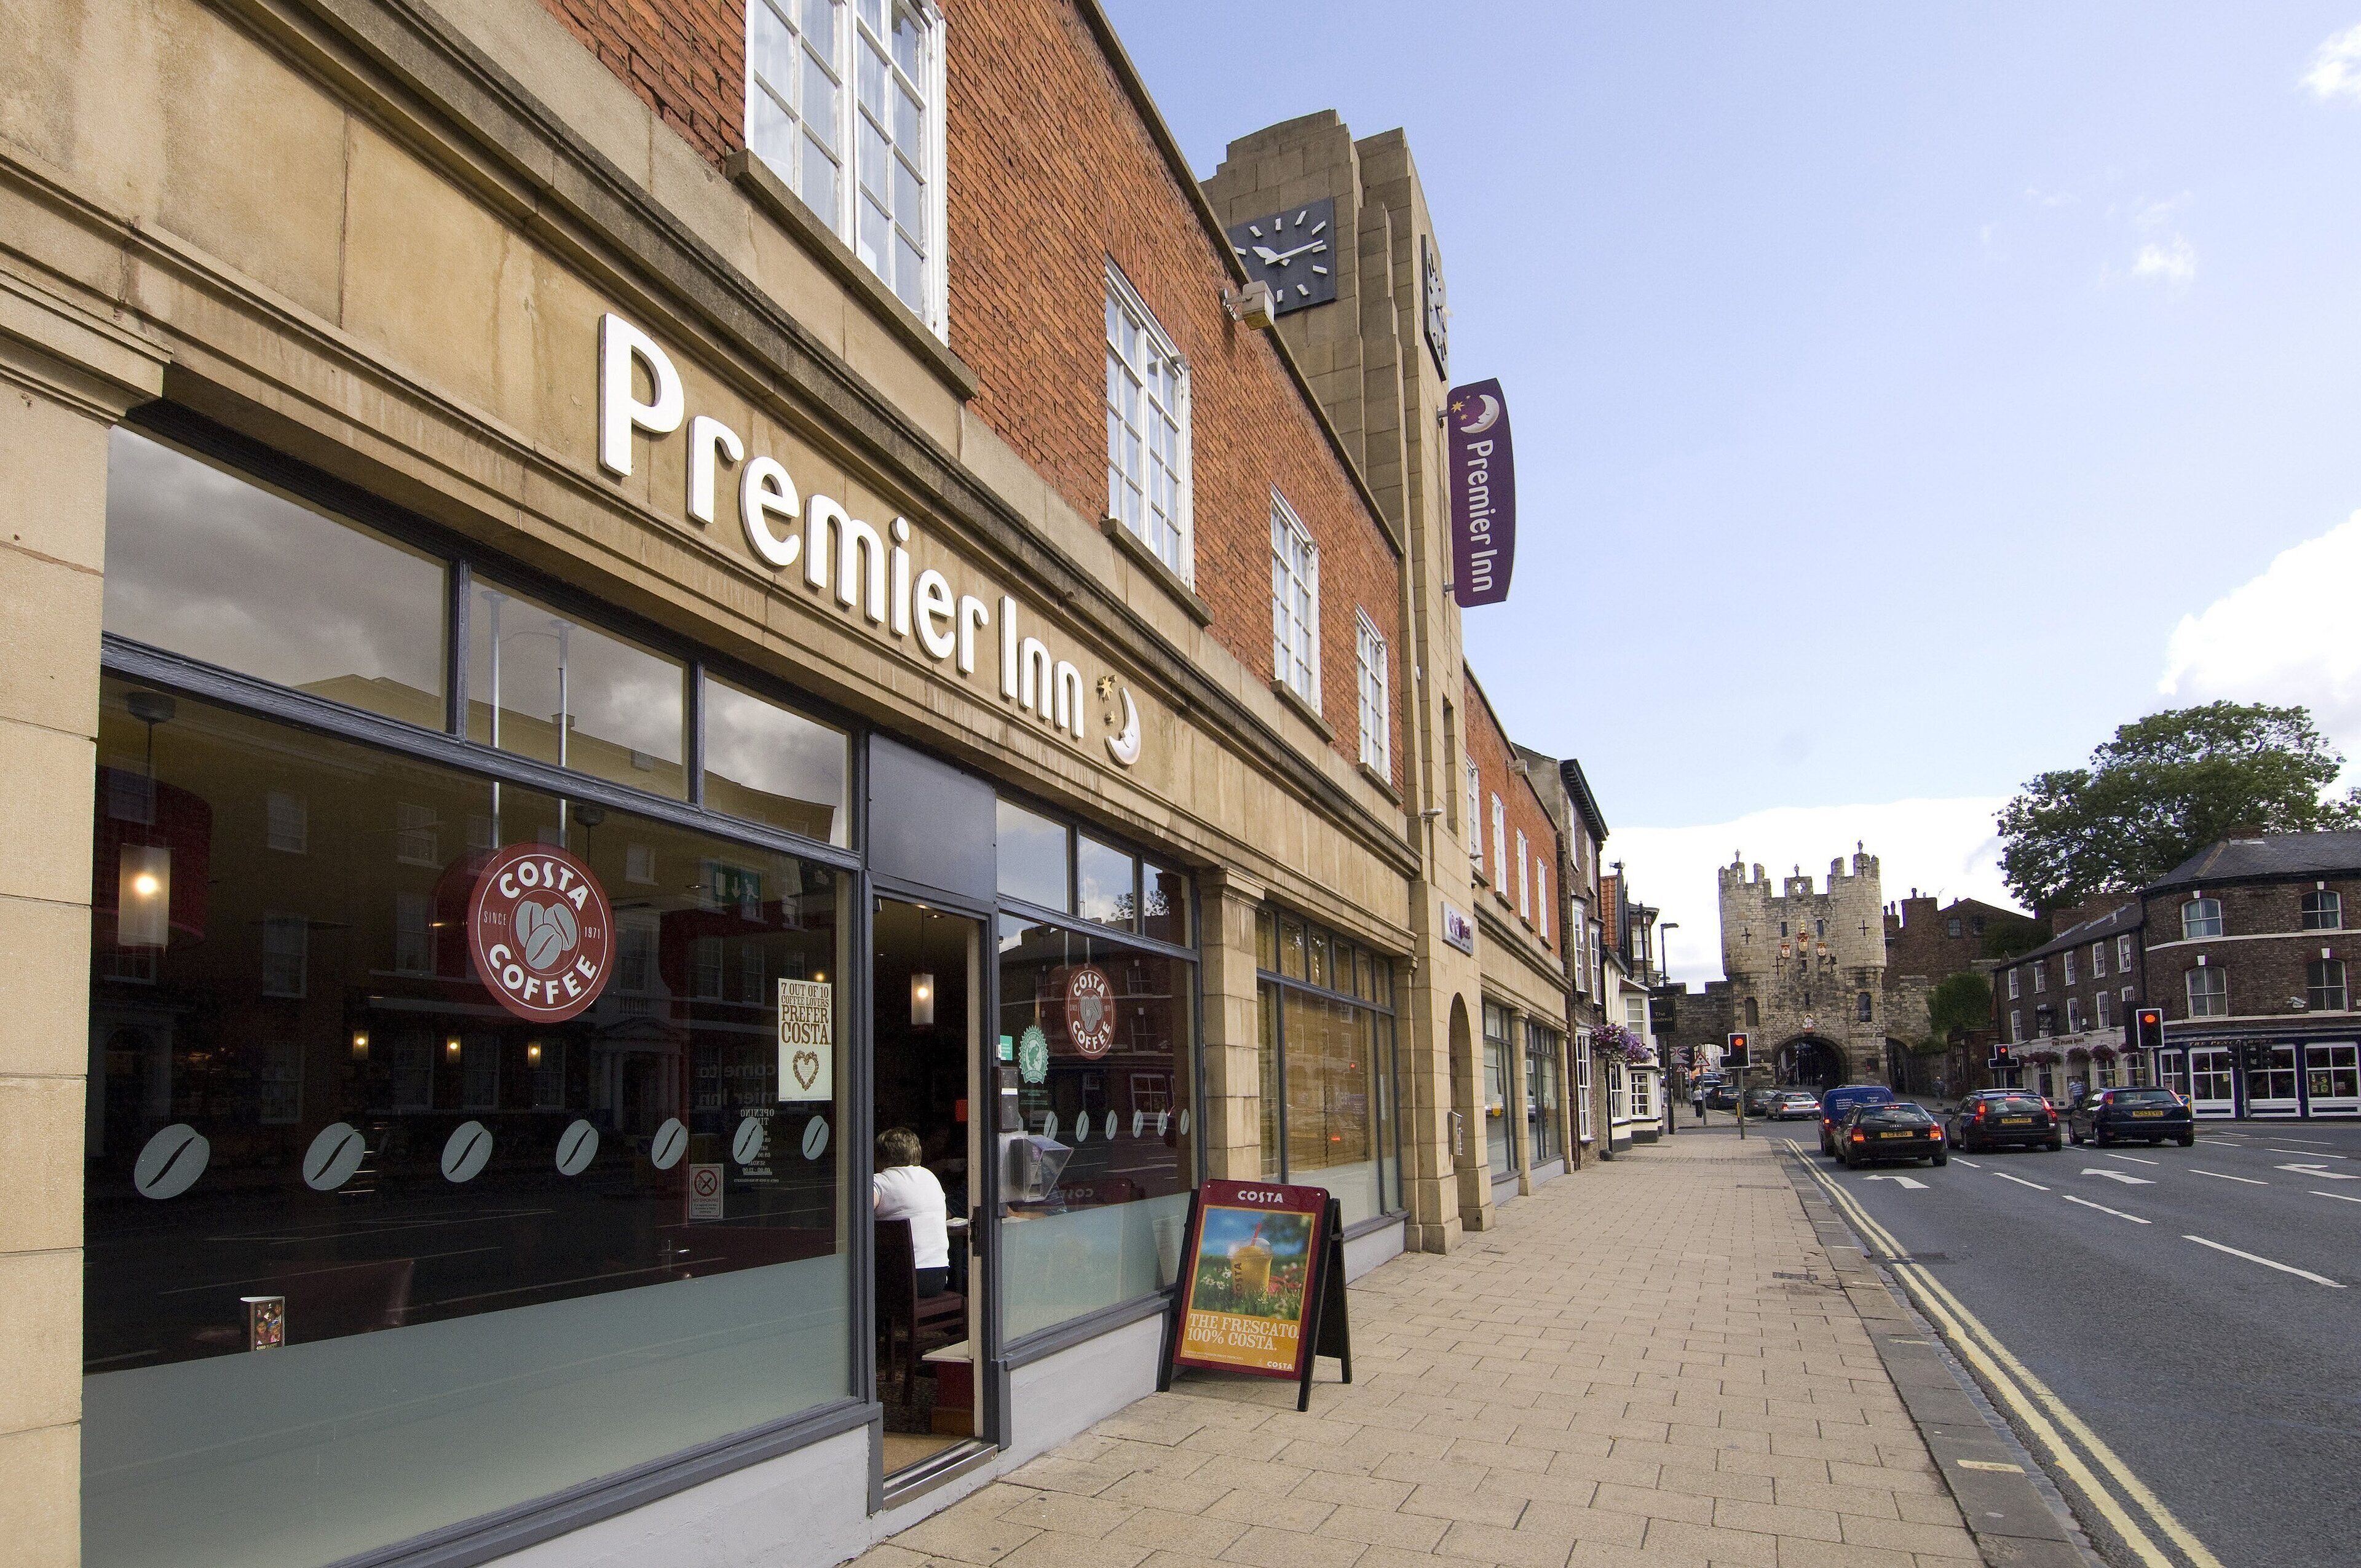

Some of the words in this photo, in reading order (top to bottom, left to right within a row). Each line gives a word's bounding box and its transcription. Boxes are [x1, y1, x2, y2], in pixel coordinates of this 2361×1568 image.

[1466, 439, 1496, 545] Premier
[598, 312, 989, 675] Premier
[999, 595, 1085, 740] Inn
[1471, 549, 1498, 592] Inn
[499, 861, 589, 911] COSTA
[483, 911, 507, 926] SINCE
[584, 926, 601, 940] 1971
[489, 944, 596, 1004] COFFEE
[1074, 973, 1105, 998] COSTA
[781, 983, 787, 994] 7
[789, 983, 805, 996] OUT
[808, 985, 818, 998] OF
[820, 986, 829, 998] 10
[781, 995, 805, 1005] COFFEE
[806, 997, 829, 1007] LOVERS
[781, 1004, 829, 1024] PREFER
[781, 1021, 831, 1045] COSTA.
[1072, 1021, 1110, 1050] COFFEE
[1238, 1190, 1284, 1203] COSTA
[1234, 1262, 1243, 1292] OSTA
[1187, 1327, 1224, 1344] 100%
[1228, 1332, 1277, 1351] COSTA.
[1190, 1313, 1218, 1329] THE
[1221, 1317, 1299, 1339] FRESCATO.
[1267, 1361, 1293, 1370] COSTA
